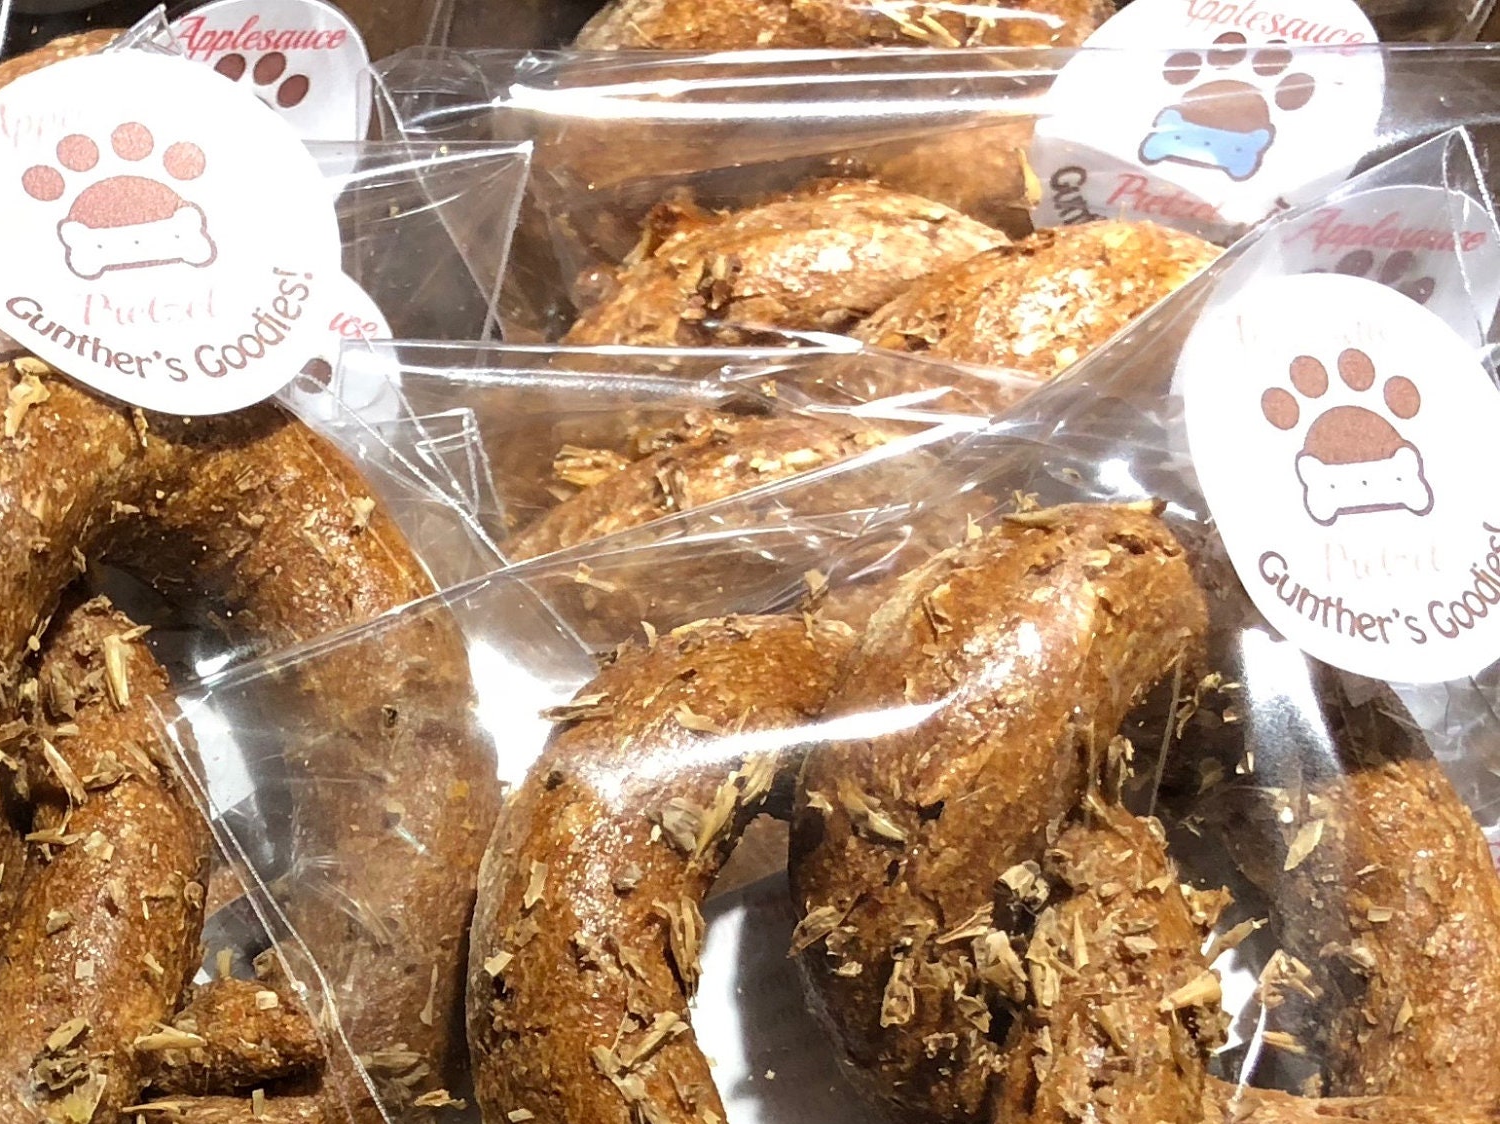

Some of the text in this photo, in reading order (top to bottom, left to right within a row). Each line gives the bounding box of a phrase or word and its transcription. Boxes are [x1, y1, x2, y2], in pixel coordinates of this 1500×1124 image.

[177, 14, 347, 62] Applesauce
[5, 267, 314, 384] Gunther's Goodies!
[1258, 550, 1427, 645] Gunther's
